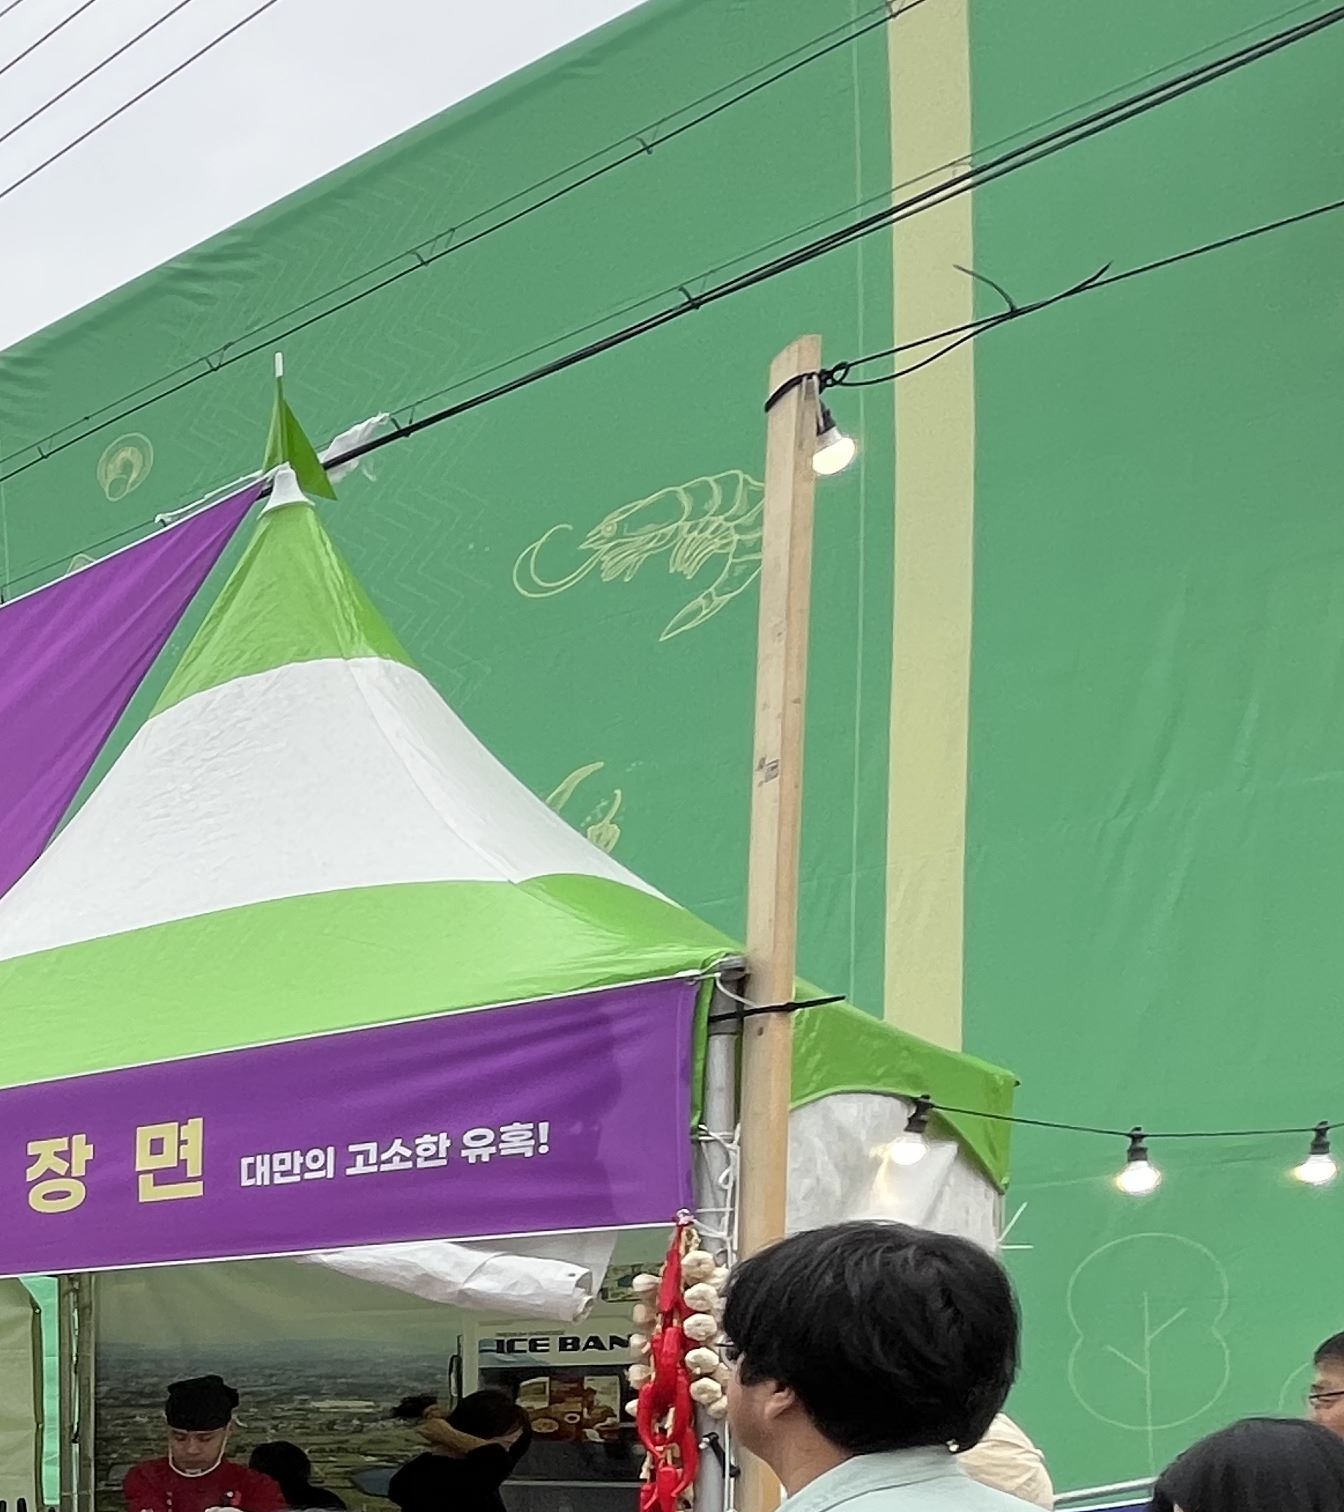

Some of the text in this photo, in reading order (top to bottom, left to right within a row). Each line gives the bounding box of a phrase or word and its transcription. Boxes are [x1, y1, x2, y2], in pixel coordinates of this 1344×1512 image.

[239, 1120, 551, 1188] 대만의 고소한 유혹!
